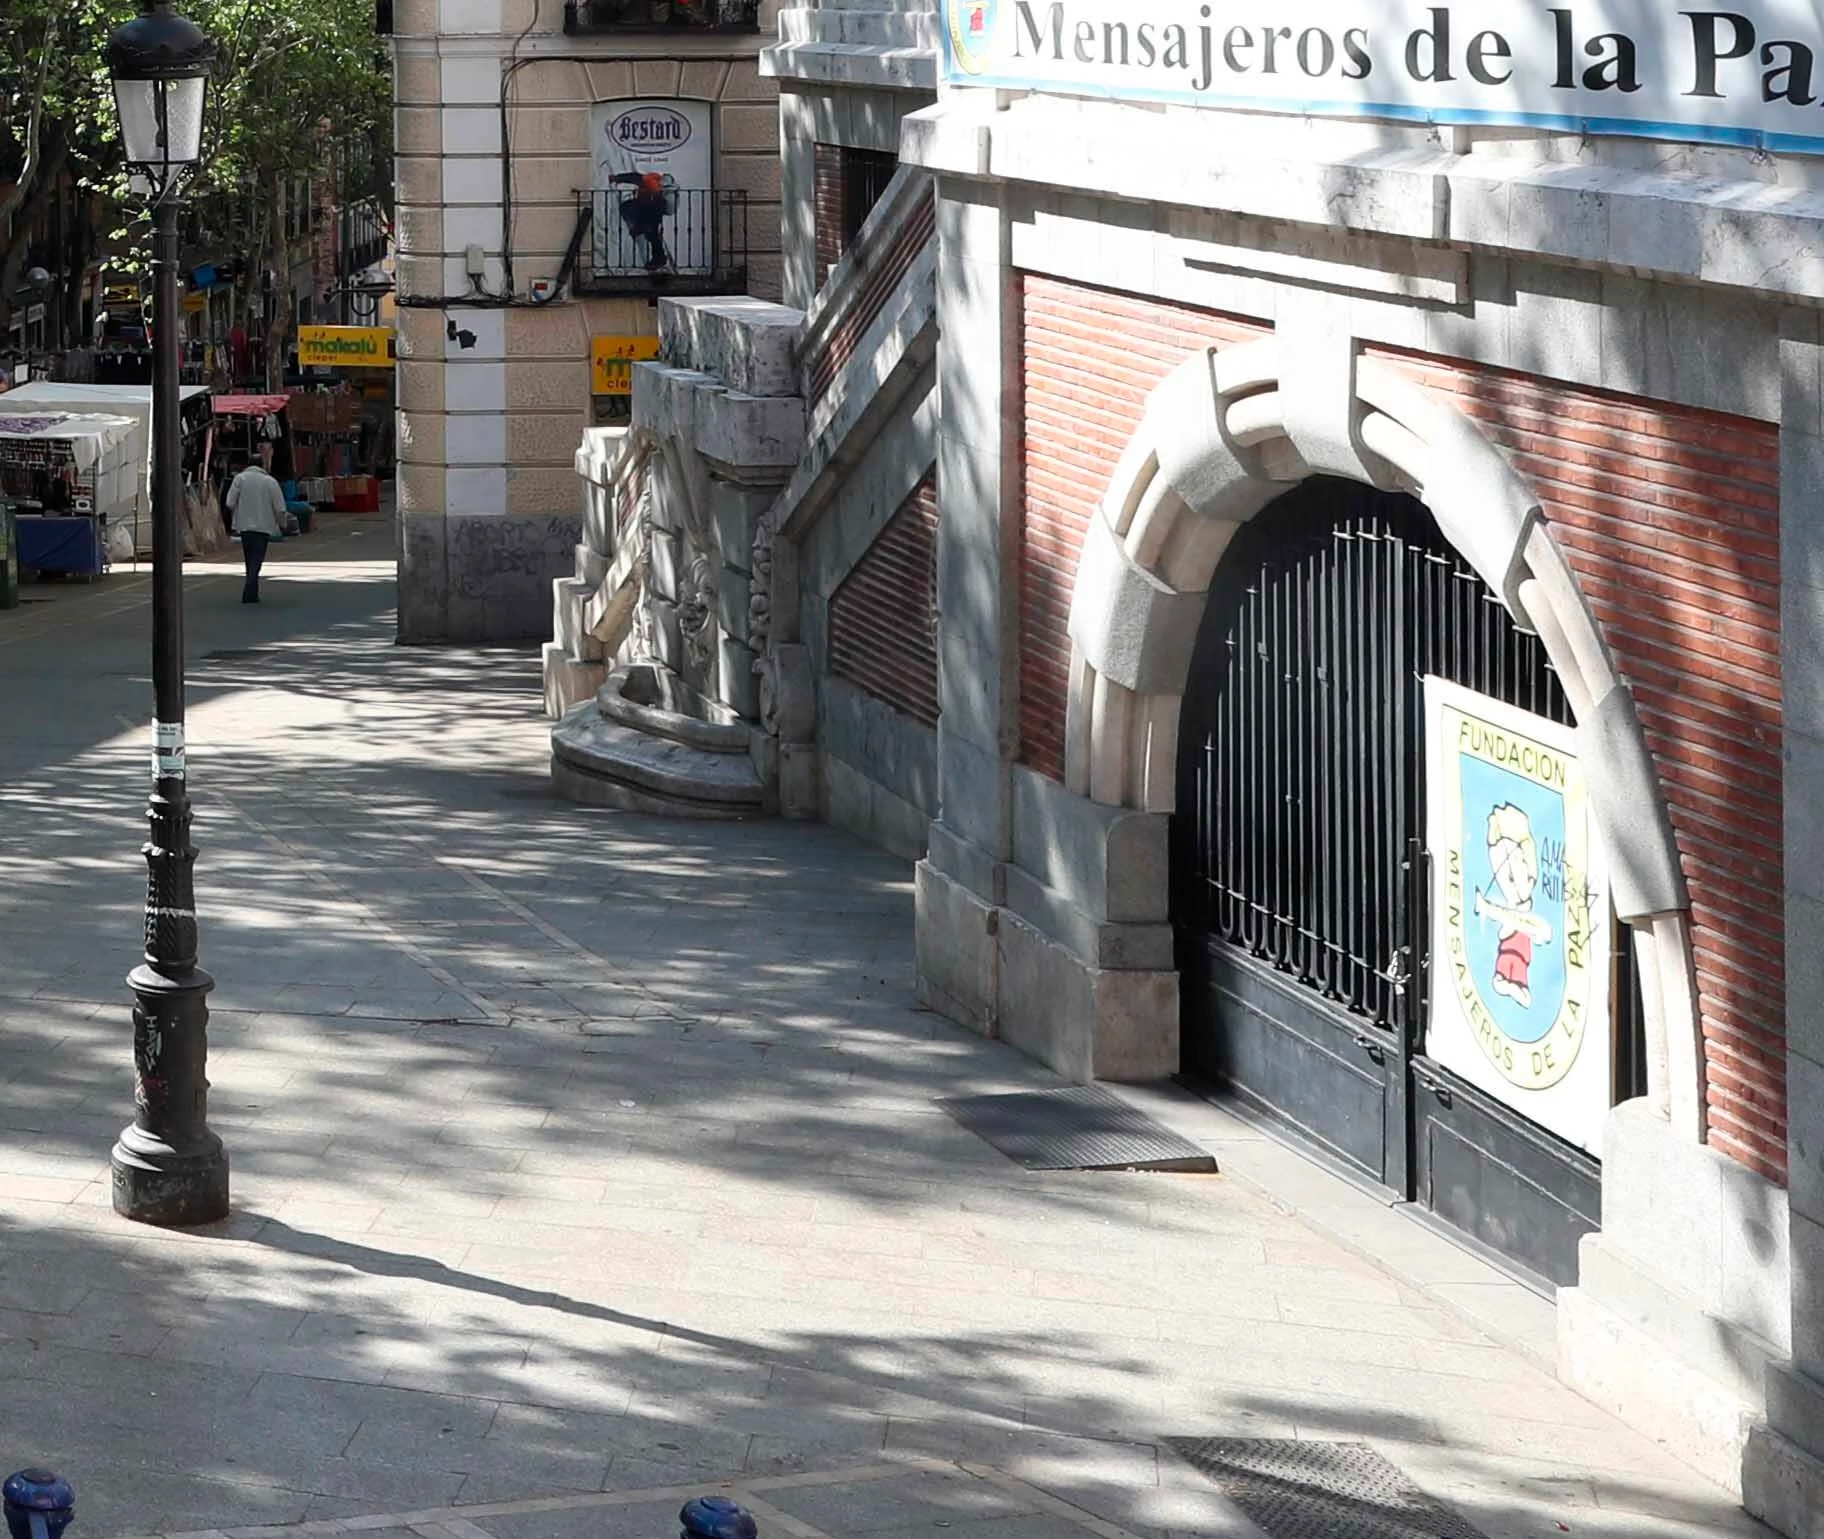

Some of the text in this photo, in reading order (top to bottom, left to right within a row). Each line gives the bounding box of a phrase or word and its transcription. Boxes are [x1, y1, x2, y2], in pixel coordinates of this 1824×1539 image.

[1012, 0, 1373, 92] Mensajeros
[1404, 7, 1514, 86] de
[1546, 8, 1643, 93] la
[1678, 10, 1824, 107] Pa
[619, 115, 682, 142] Bestard
[1458, 719, 1567, 788] FUNDACION
[1448, 849, 1514, 1071] MENSAJEROS
[1531, 1043, 1556, 1077] DE
[1561, 998, 1582, 1039] LA
